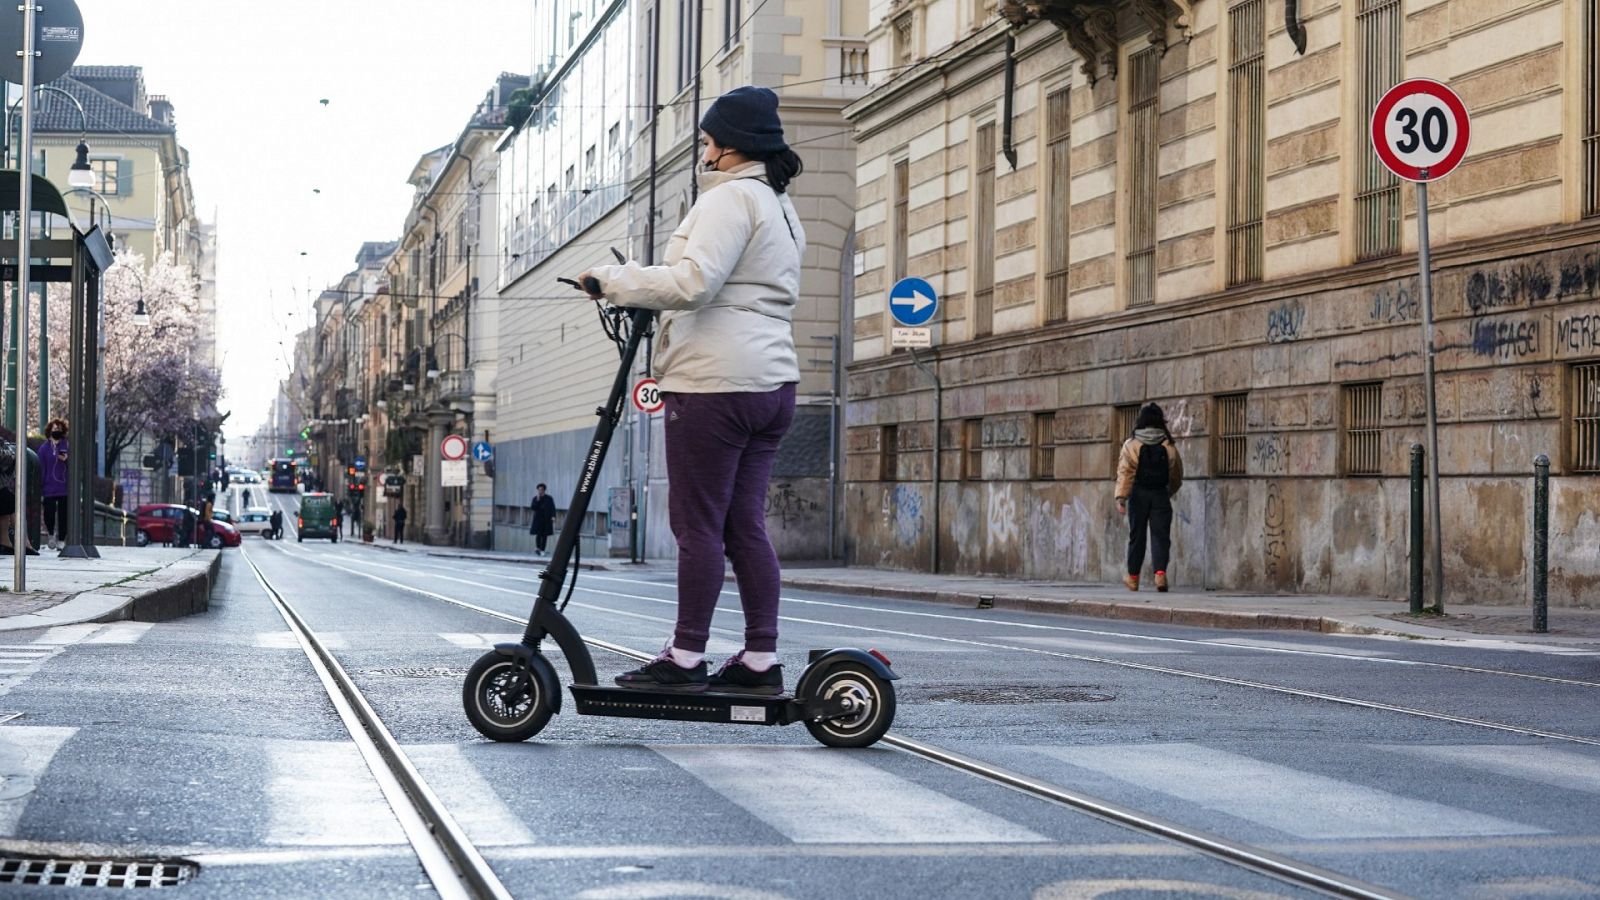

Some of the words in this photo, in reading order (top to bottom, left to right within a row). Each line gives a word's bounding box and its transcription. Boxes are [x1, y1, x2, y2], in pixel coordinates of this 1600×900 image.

[1395, 106, 1449, 154] 30
[641, 387, 659, 404] 30
[580, 440, 604, 493] www.zbike.it
